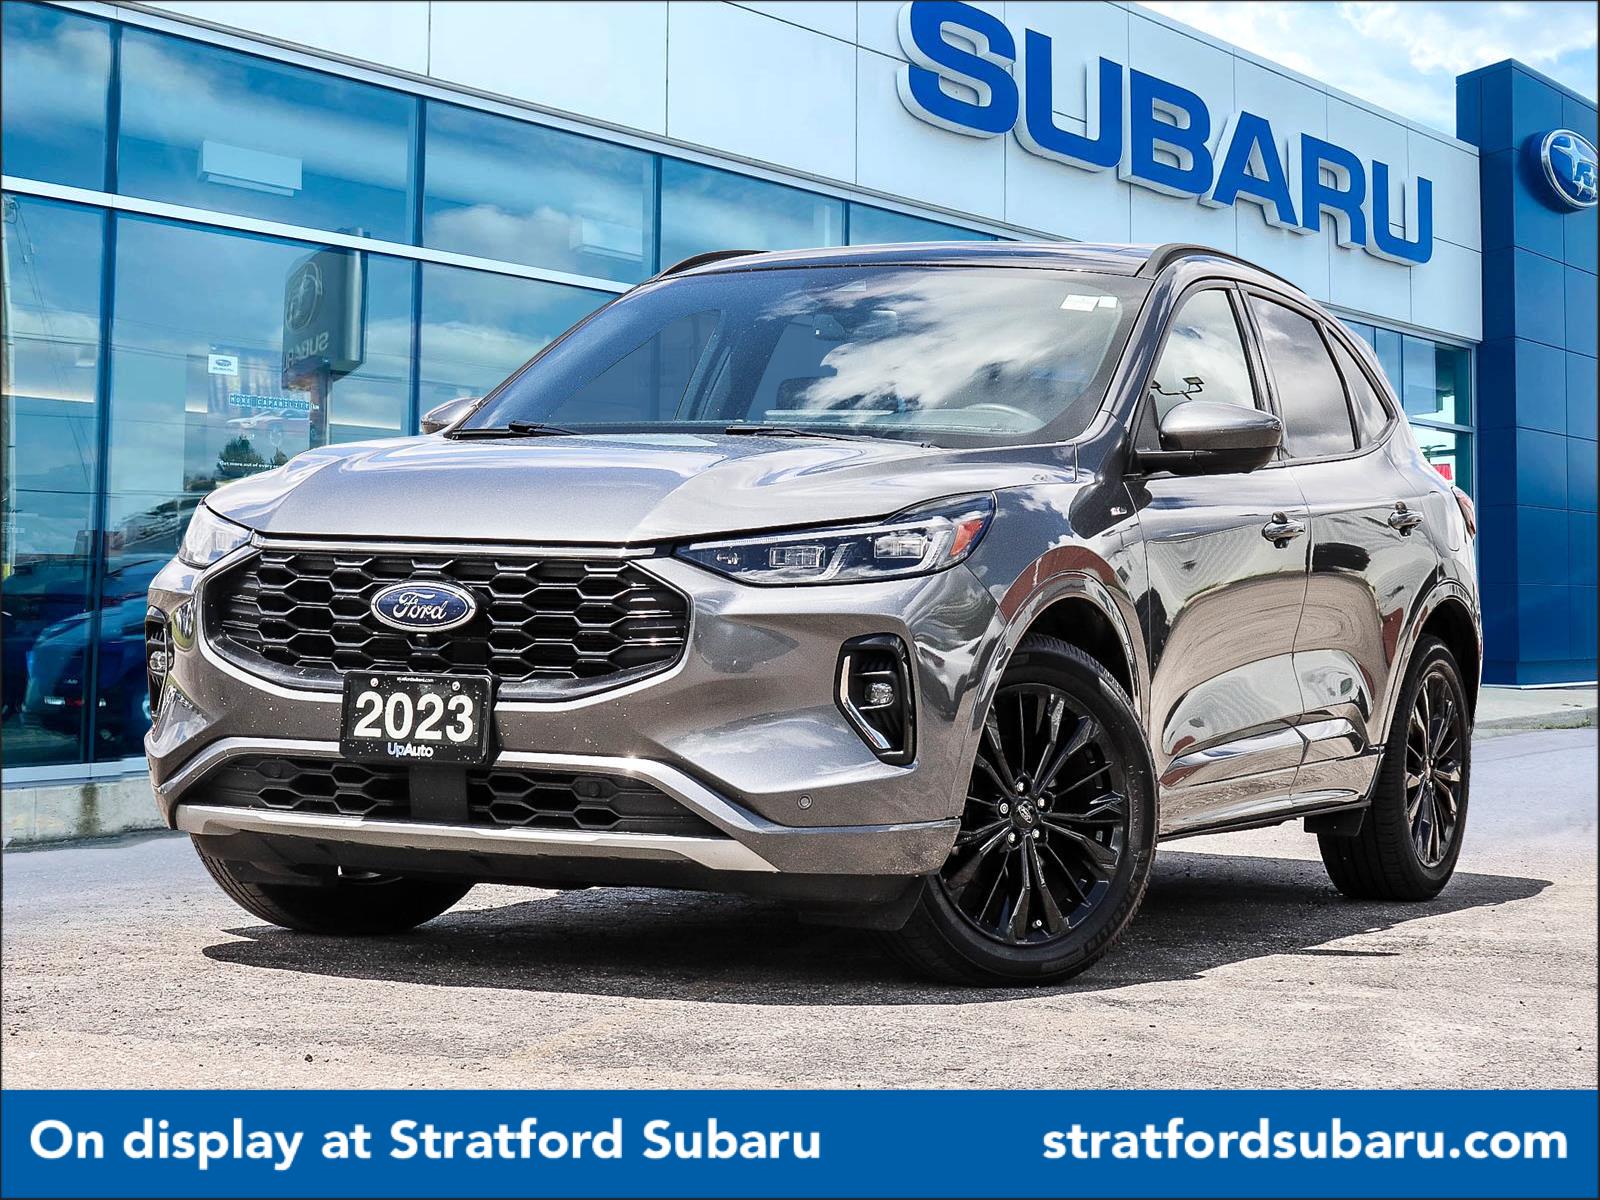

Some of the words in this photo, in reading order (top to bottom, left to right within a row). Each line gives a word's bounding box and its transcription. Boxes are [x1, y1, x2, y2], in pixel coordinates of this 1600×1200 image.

[899, 0, 1433, 265] SUBARU
[393, 591, 448, 620] Ford
[353, 690, 474, 742] 2023
[387, 742, 434, 758] UpAuto
